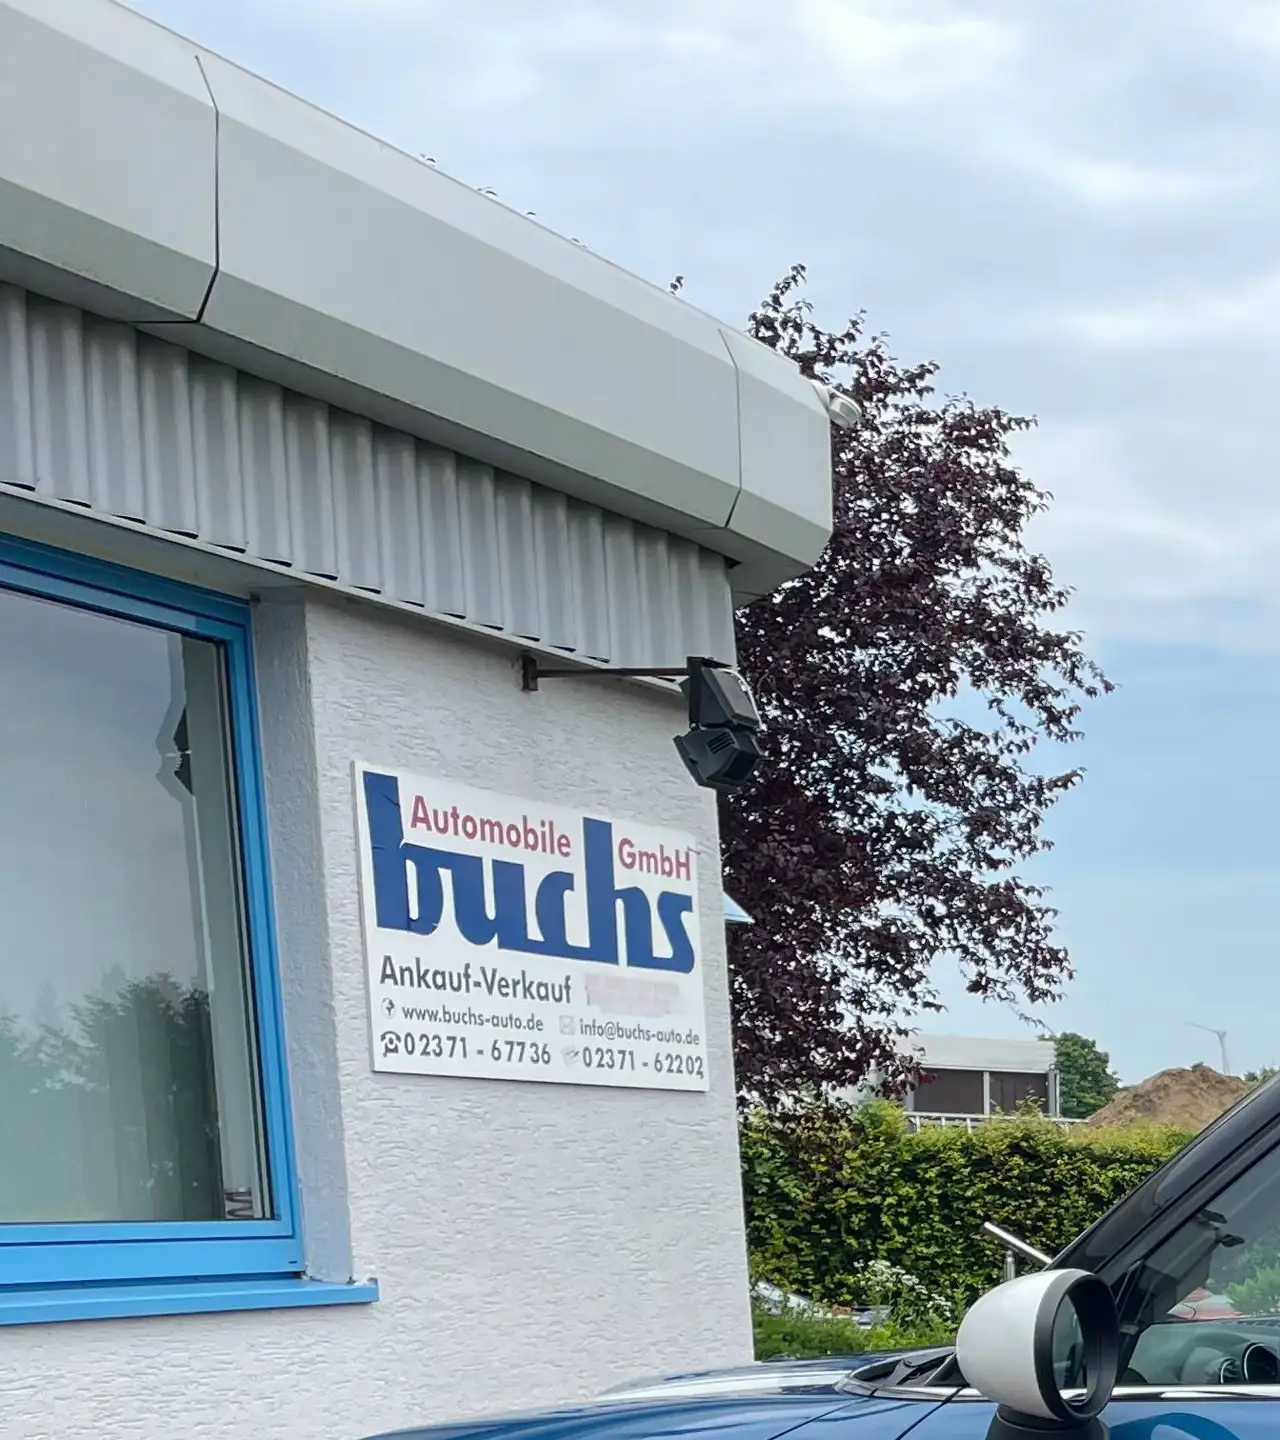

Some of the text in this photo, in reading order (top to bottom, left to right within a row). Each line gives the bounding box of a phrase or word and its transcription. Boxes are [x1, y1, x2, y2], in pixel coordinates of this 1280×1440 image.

[410, 795, 692, 881] Automobile GmbH
[363, 770, 696, 974] buchs
[380, 955, 572, 1003] Ankauf-Verkauf
[402, 1004, 544, 1032] www.buchs-auto.de
[580, 1018, 700, 1046] info@buchs-auto.de
[404, 1032, 468, 1059] 02371
[491, 1039, 552, 1065] 67736
[583, 1047, 635, 1071] 02371
[654, 1053, 704, 1079] 62202
